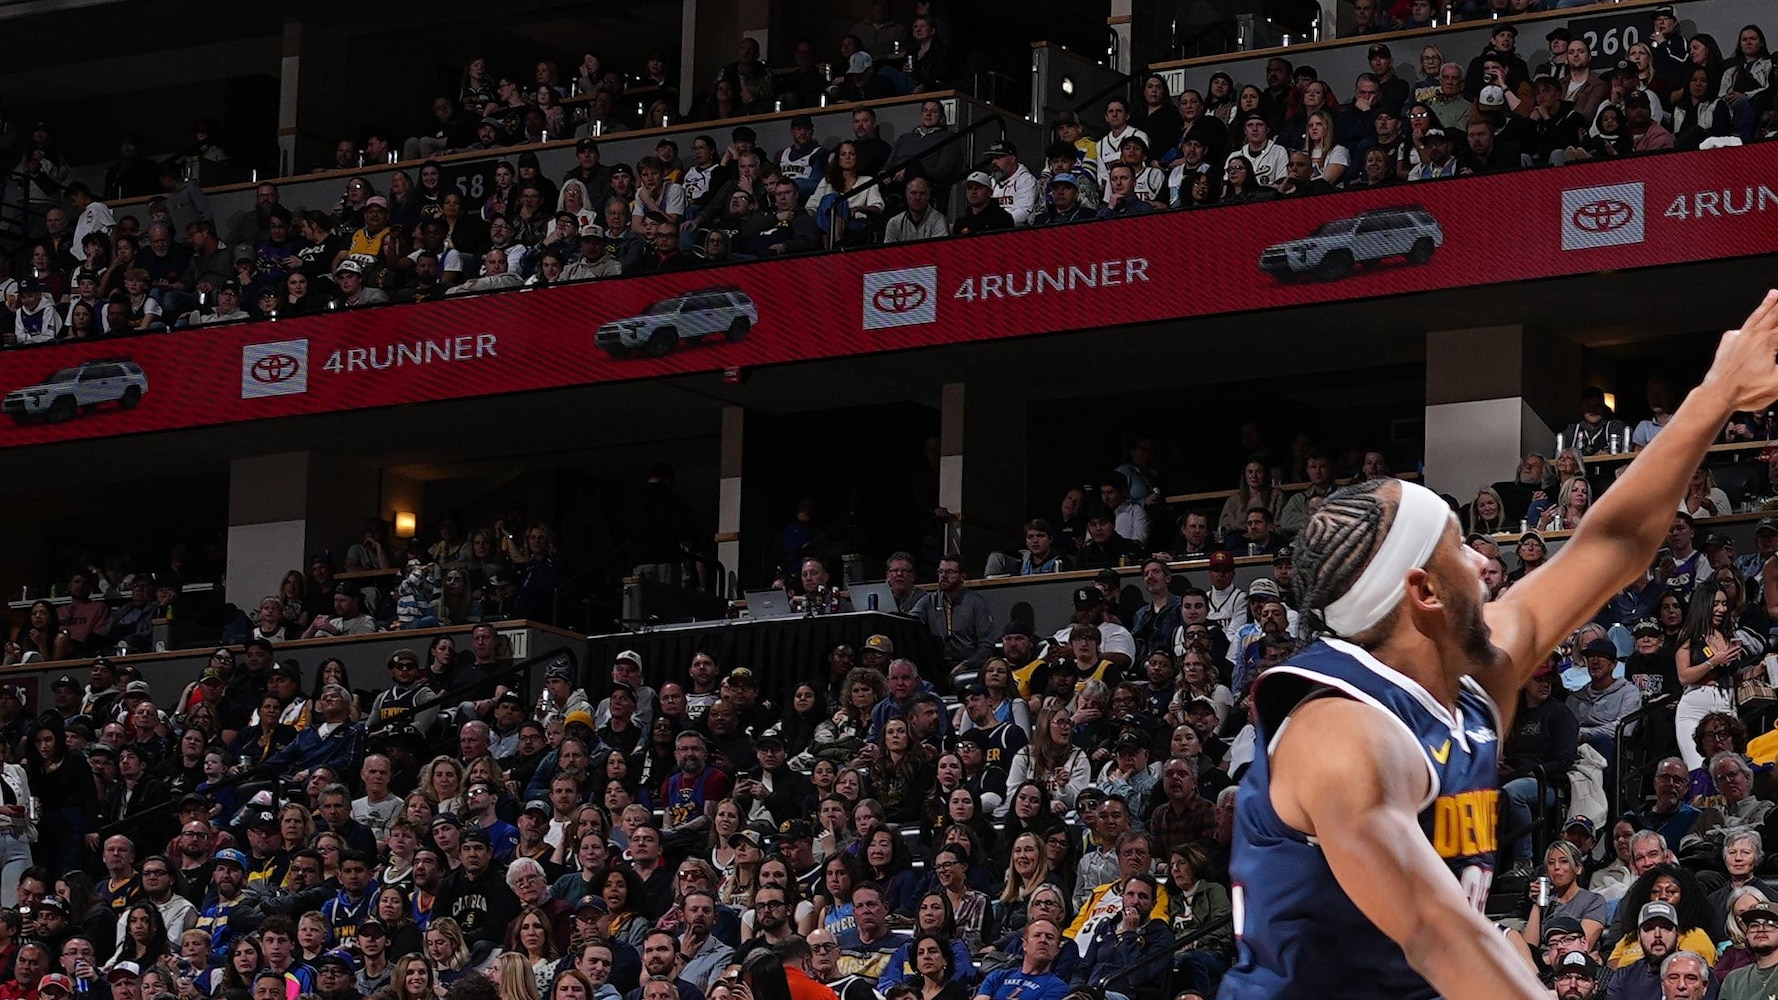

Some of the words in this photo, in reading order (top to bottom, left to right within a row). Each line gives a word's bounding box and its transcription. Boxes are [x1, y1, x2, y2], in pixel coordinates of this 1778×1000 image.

[1582, 26, 1639, 57] 260
[1164, 72, 1183, 96] XIT
[954, 257, 1150, 302] 4RUNNER
[322, 333, 498, 374] 4RUNNER
[333, 924, 358, 940] DENV
